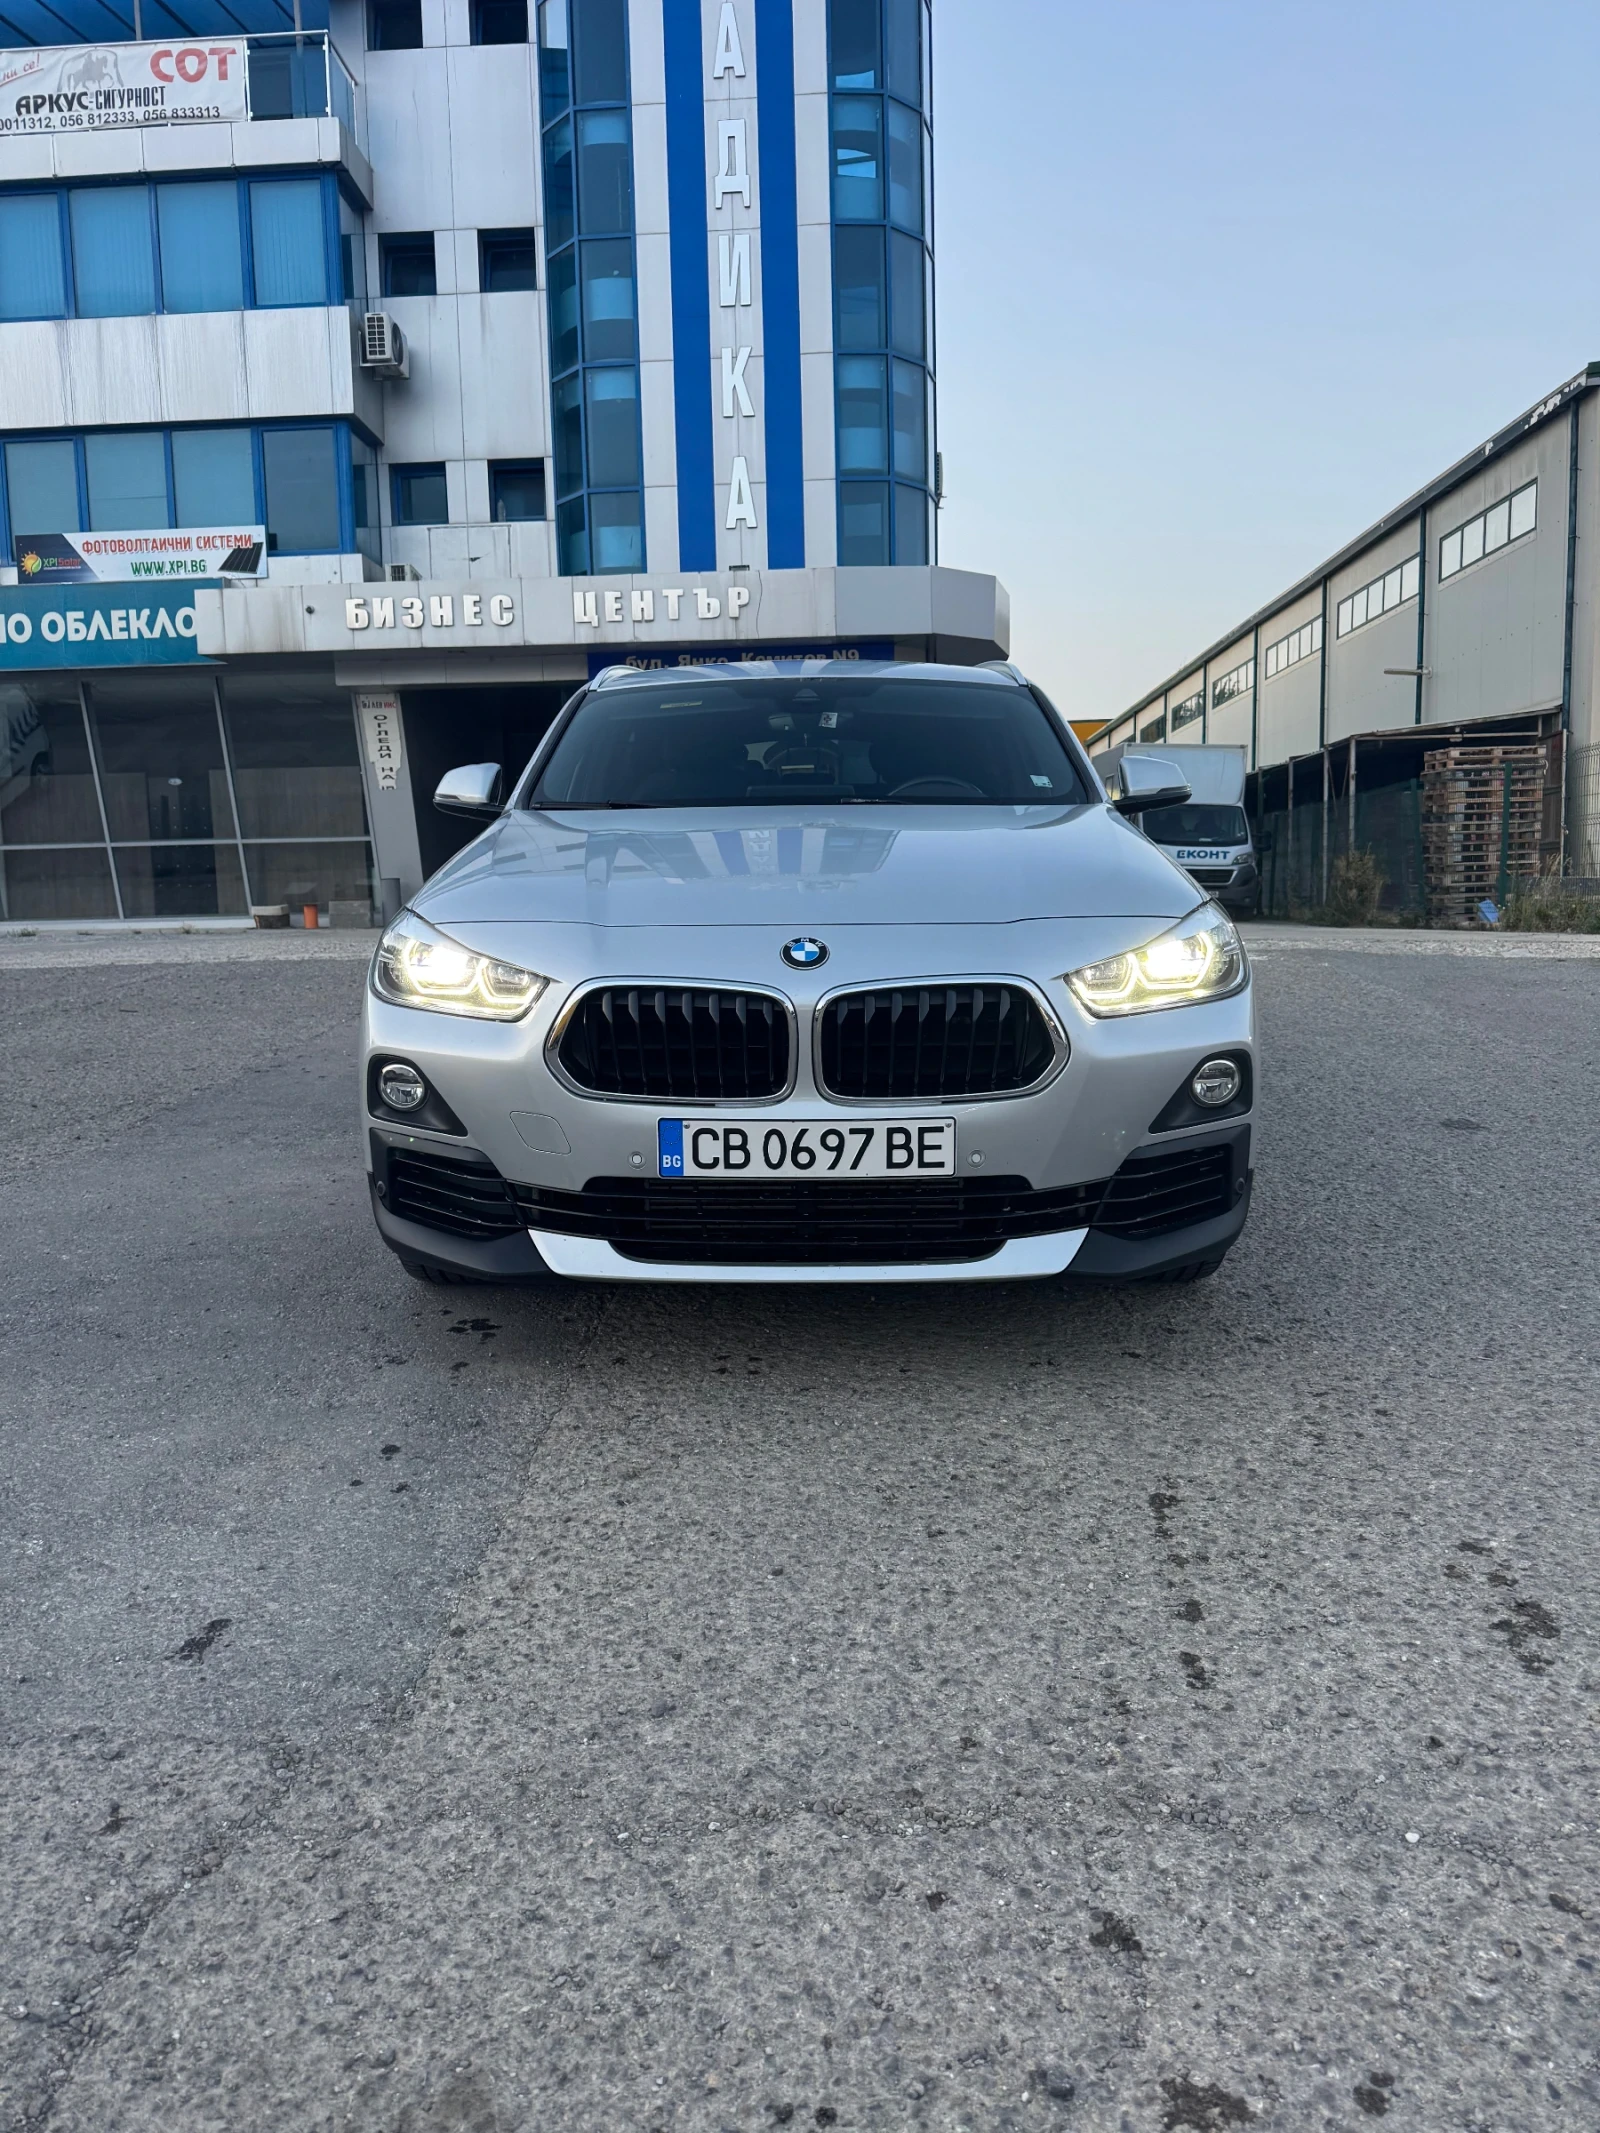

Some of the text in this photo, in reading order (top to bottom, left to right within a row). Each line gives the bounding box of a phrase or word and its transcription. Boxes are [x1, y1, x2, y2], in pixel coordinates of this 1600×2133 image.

[150, 47, 237, 83] СОТ
[15, 85, 166, 117] АРКУС-СИГУРНОСТ
[60, 114, 83, 127] 056
[87, 111, 139, 125] 812333,
[143, 108, 167, 121] 056
[171, 106, 220, 119] 833313
[82, 534, 253, 554] ФОТОВОЛТАИЧНИ СИСТЕМИ
[130, 559, 207, 576] WWW.XPI.BG
[345, 587, 750, 630] БИЗНЕС ЦЕНТЪР
[0, 607, 196, 643] О ОБЛЕКЛО
[1176, 849, 1230, 860] ЕКОНТ
[786, 938, 825, 947] BMW
[662, 1126, 946, 1170] BG CB 0697 BE
